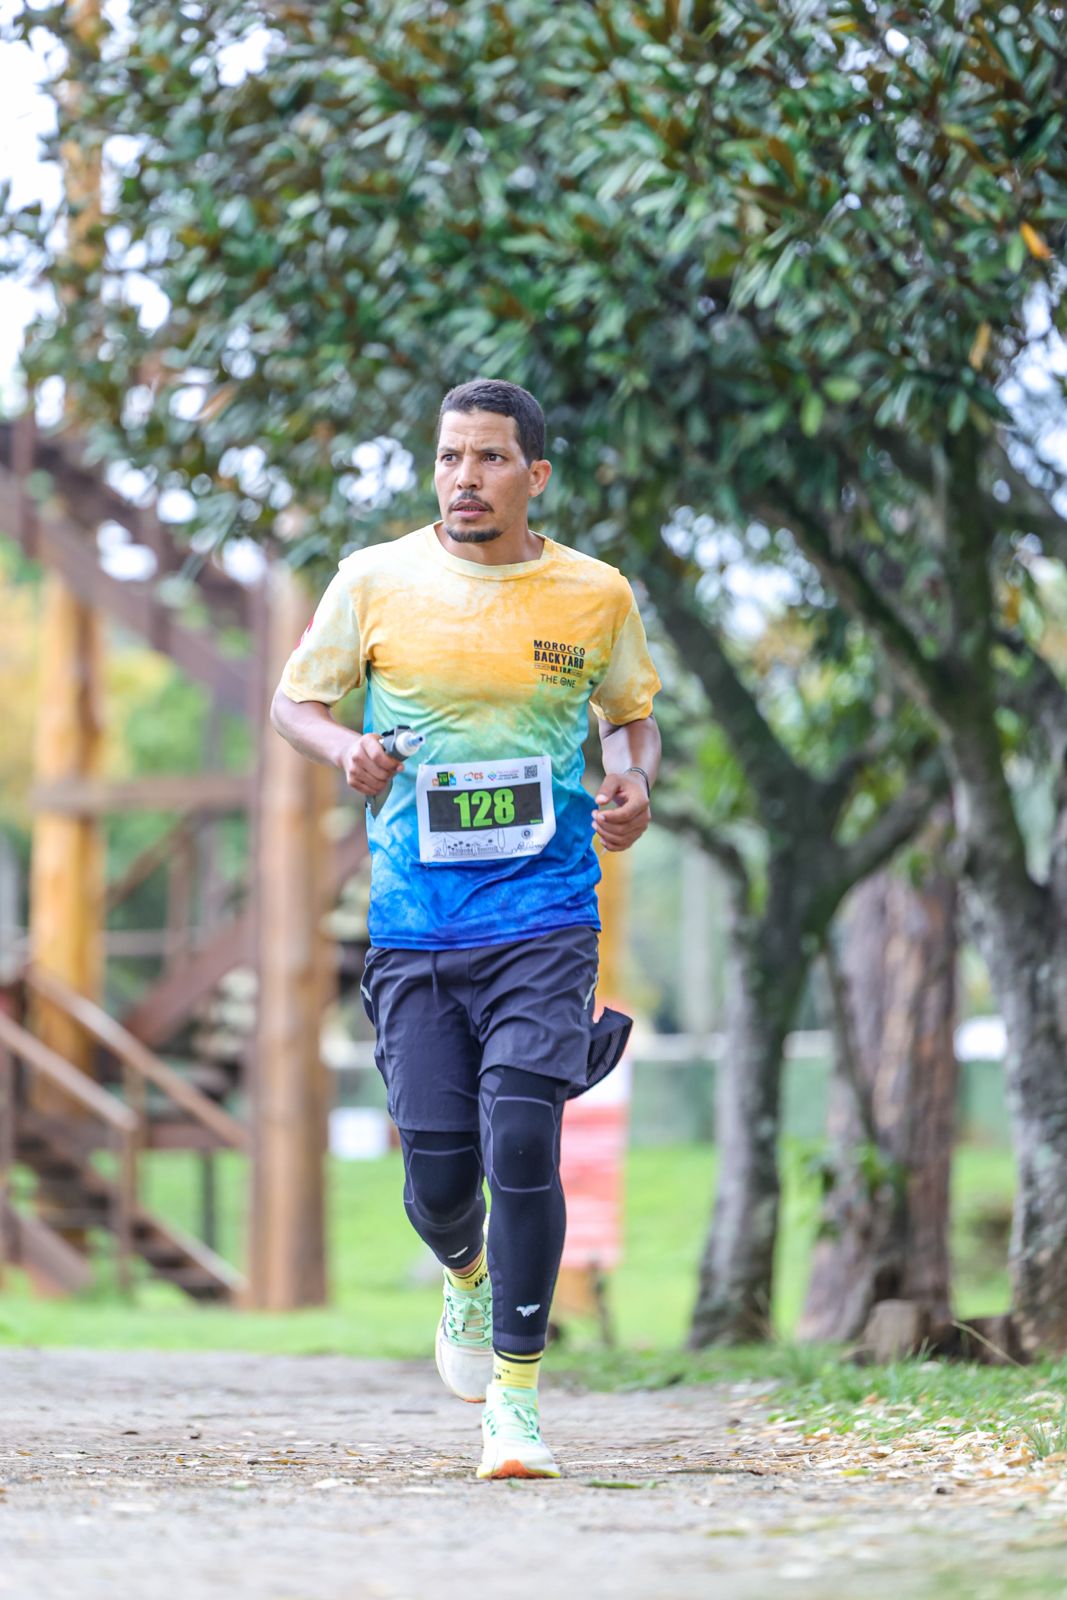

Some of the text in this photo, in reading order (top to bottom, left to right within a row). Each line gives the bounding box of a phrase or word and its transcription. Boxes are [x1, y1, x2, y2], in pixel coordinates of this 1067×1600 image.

[534, 640, 585, 656] MOROCCO
[534, 650, 584, 669] BACKYARD
[540, 673, 558, 684] THE
[454, 788, 515, 828] 128
